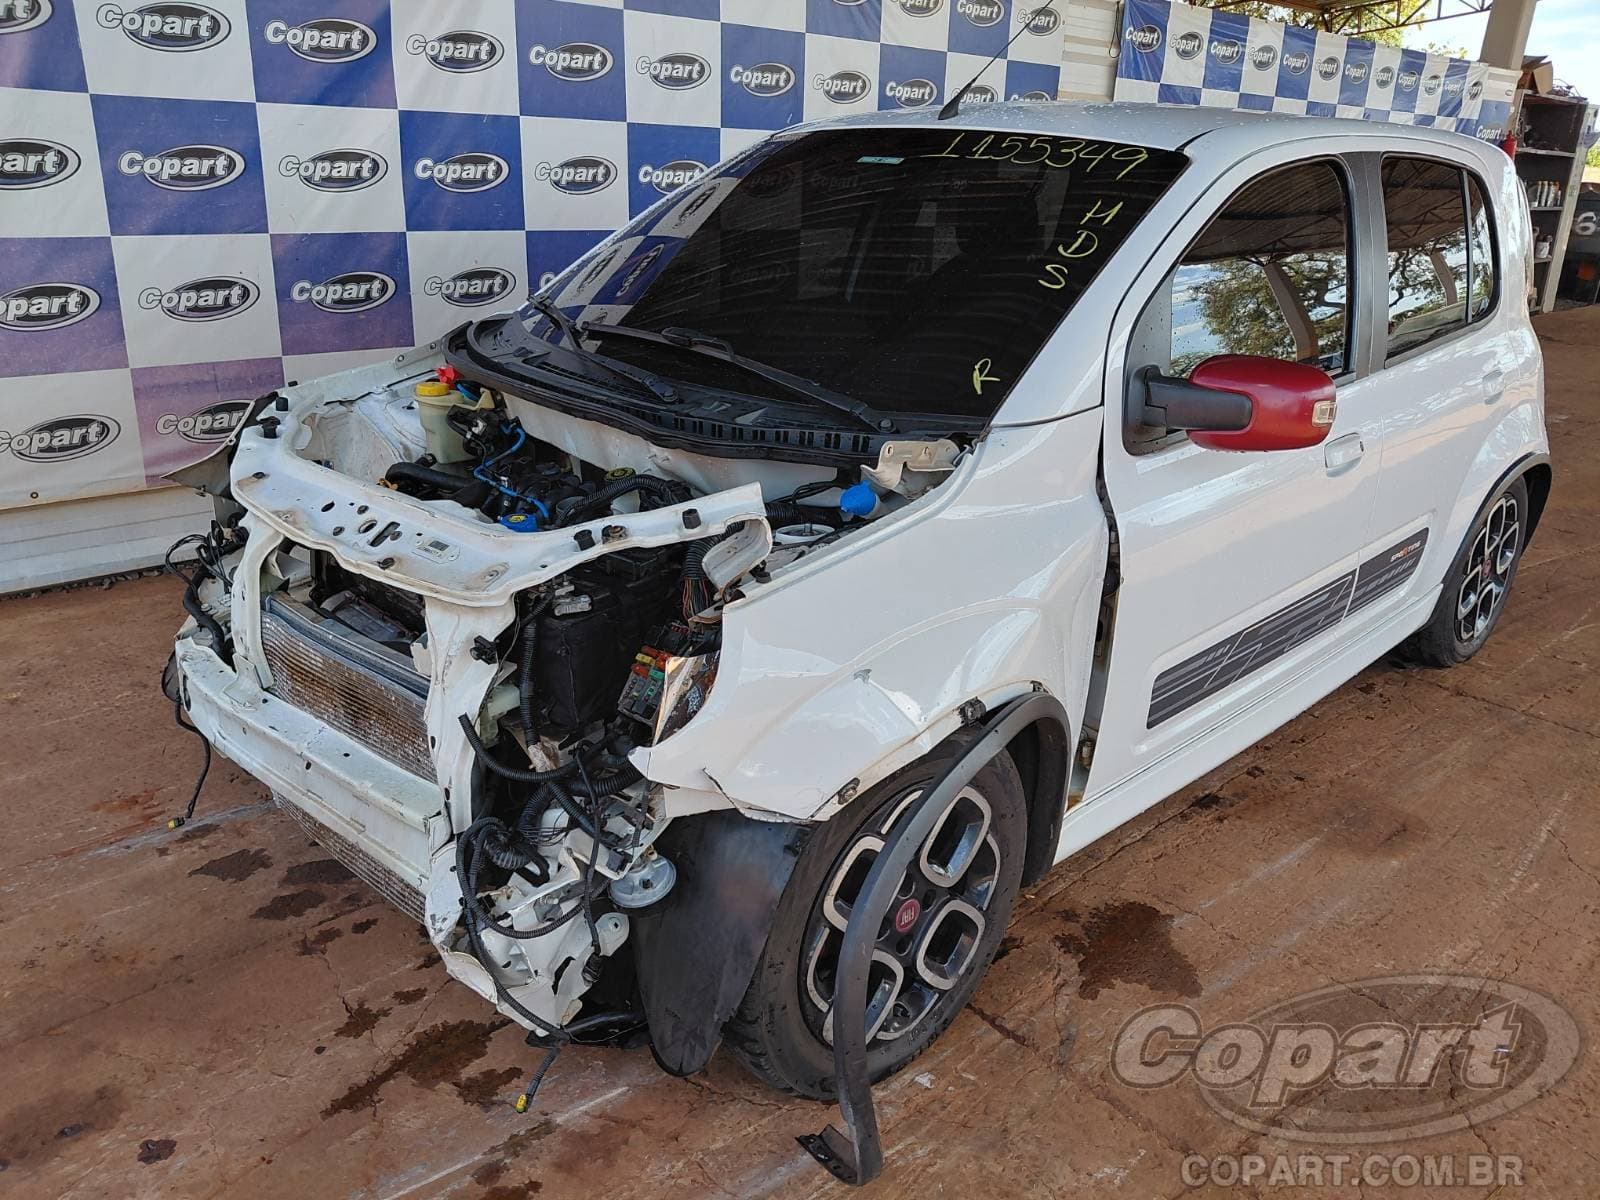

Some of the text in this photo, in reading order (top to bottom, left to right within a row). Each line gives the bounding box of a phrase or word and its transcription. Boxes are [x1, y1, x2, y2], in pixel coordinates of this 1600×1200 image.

[96, 3, 213, 37] Copart
[956, 0, 998, 18] Copart
[1017, 9, 1054, 27] Copart
[265, 20, 362, 51] Copart
[406, 33, 491, 61] Copart
[1125, 27, 1159, 45] Copart
[1169, 34, 1199, 52] Copart
[529, 44, 603, 71] Copart
[1210, 41, 1239, 58] Copart
[1283, 53, 1307, 69] Copart
[635, 56, 701, 81] Copart
[730, 65, 788, 87] Copart
[812, 73, 864, 95] Copart
[885, 81, 931, 101] Copart
[1476, 125, 1502, 140] Copart
[119, 150, 228, 180] Copart
[279, 154, 374, 182] Copart
[414, 157, 497, 182] Copart
[535, 161, 607, 183] Copart
[138, 285, 243, 312] Copart
[290, 276, 383, 305] Copart
[424, 274, 504, 299] Copart
[156, 411, 244, 436] Copar
